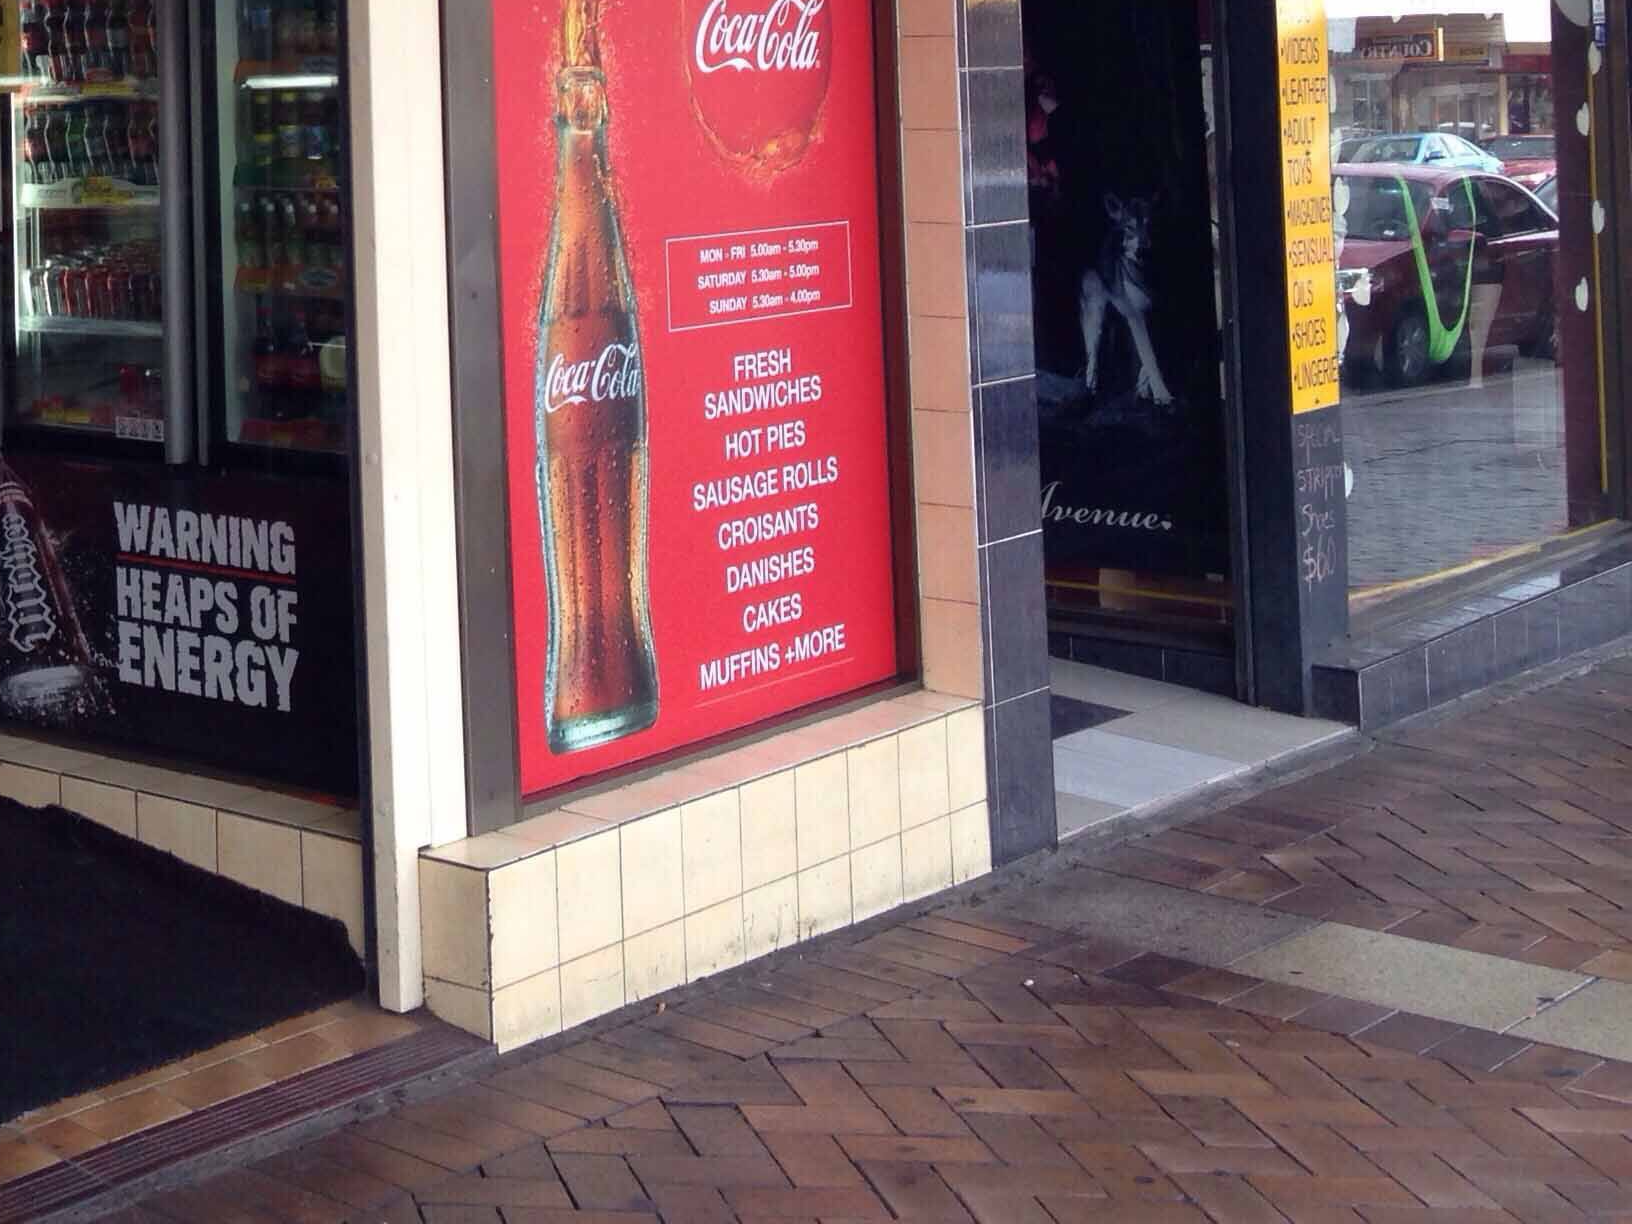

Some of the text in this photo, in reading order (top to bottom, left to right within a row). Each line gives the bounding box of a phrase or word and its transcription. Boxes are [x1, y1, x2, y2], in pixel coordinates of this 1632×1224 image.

[1284, 36, 1320, 65] VIDEOS
[1285, 76, 1328, 106] LEATHER
[1287, 117, 1316, 146] ADULT
[1287, 157, 1313, 186] TOYS
[700, 247, 723, 264] MON
[730, 245, 746, 261] FRI
[1291, 236, 1335, 268] SENSUAL
[698, 271, 748, 290] SATURDAY
[1293, 279, 1314, 309] OILS
[709, 296, 748, 315] SUNDAY
[1295, 318, 1326, 350] SHOES
[544, 343, 642, 415] Coca-Cola
[733, 347, 792, 380] FRESH
[1296, 356, 1339, 391] LINGERIE
[704, 374, 822, 421] SANDWICHES
[724, 420, 806, 462] HOT PIES
[692, 455, 839, 513] SAUSAGE ROLLS
[113, 501, 297, 575] WARNING
[718, 502, 820, 551] CROISANTS
[726, 546, 816, 594] DANISHES
[116, 566, 298, 644] HEAPS OF
[743, 593, 803, 634] CAKES
[117, 621, 299, 713] ENERGY
[700, 623, 847, 691] MUFFINS +MORE
